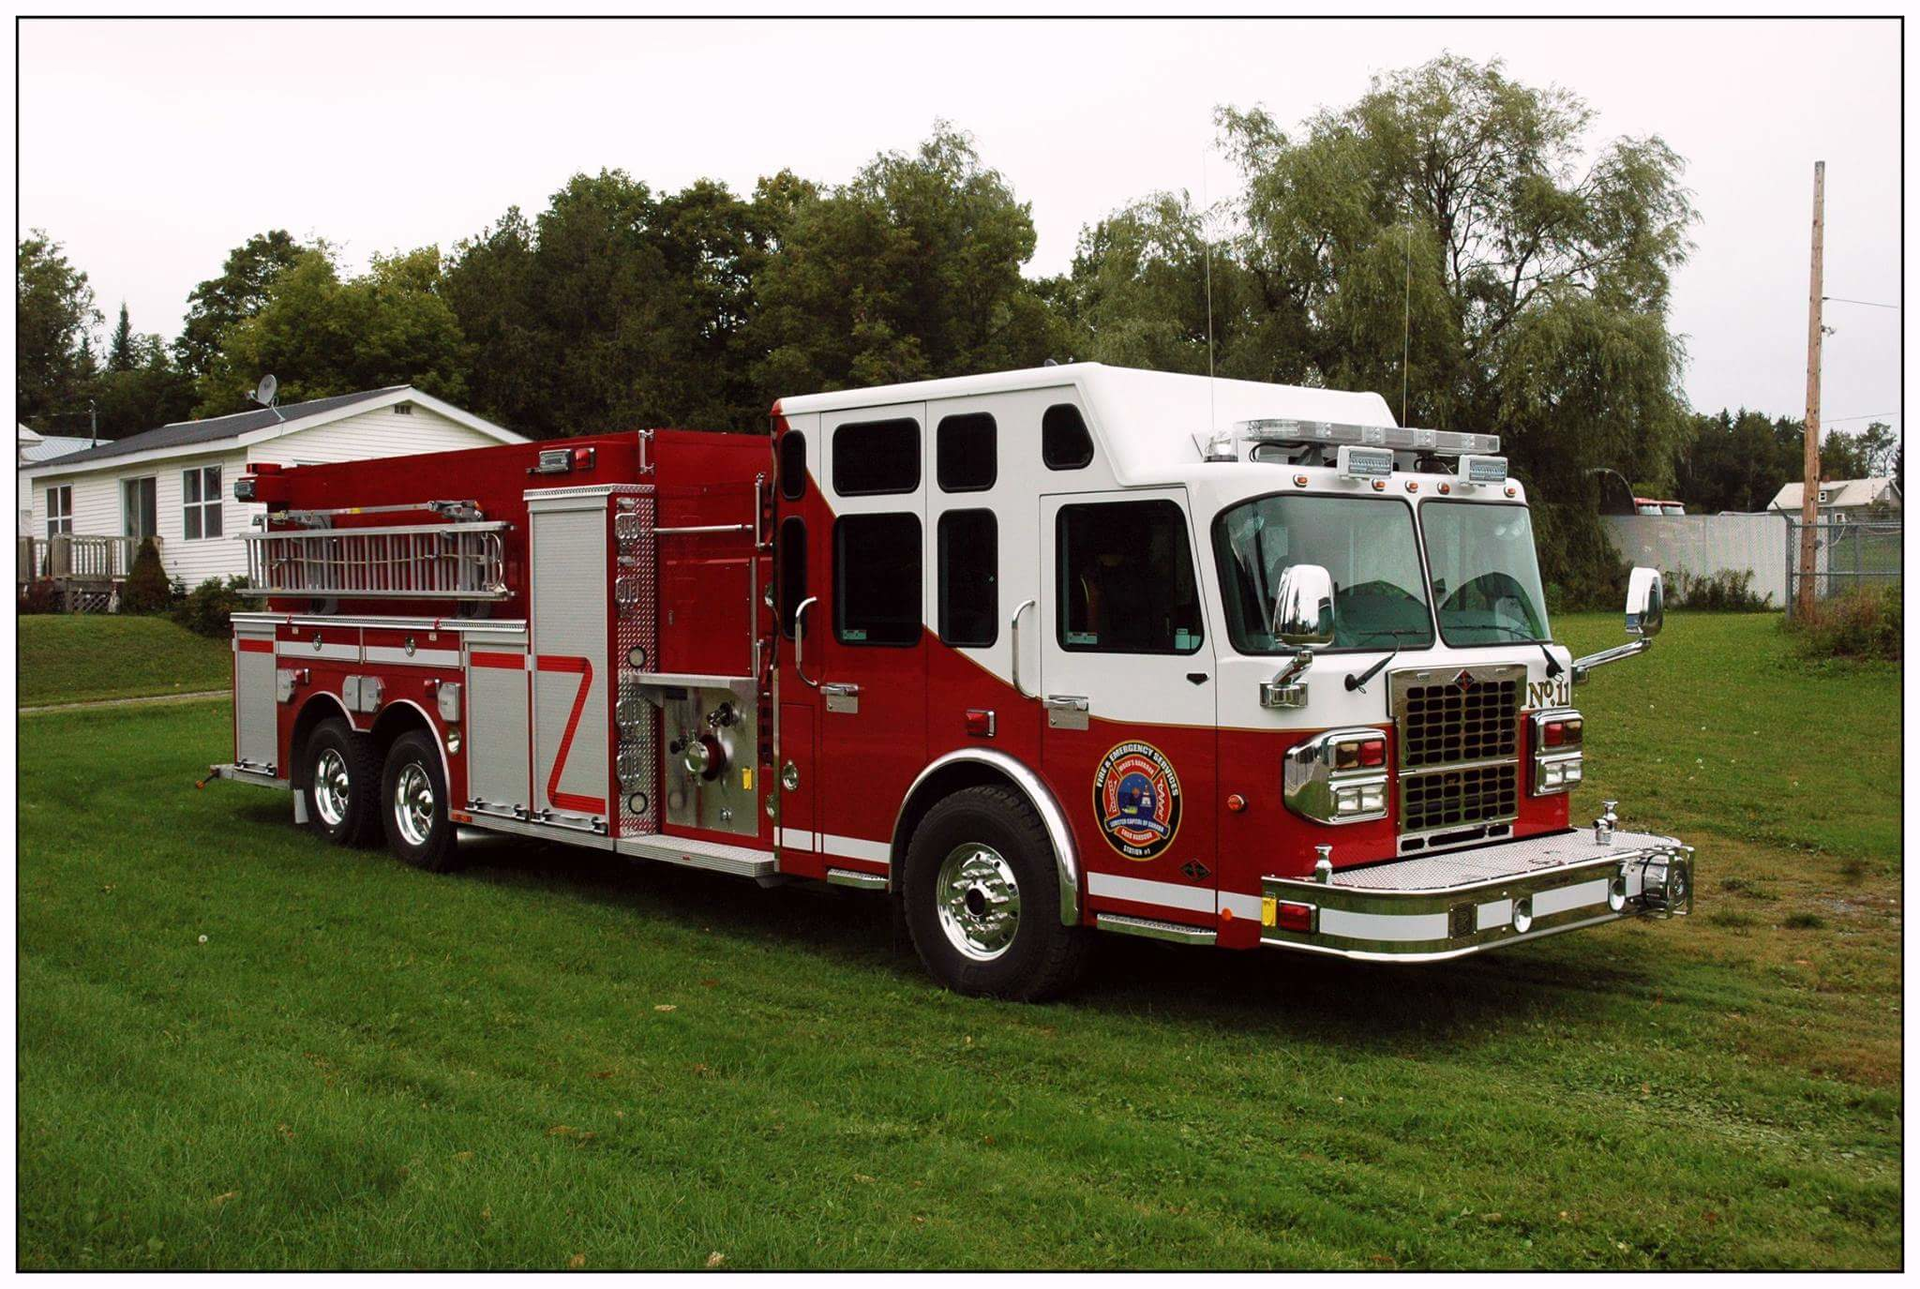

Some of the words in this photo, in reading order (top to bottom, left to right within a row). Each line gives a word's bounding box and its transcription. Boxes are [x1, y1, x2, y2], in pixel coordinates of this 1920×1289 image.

[1096, 767, 1107, 788] FIRE
[1105, 760, 1112, 768] &
[1109, 744, 1154, 761] EMERGENCY
[1153, 752, 1179, 796] SERVICES
[1123, 845, 1143, 855] STATION
